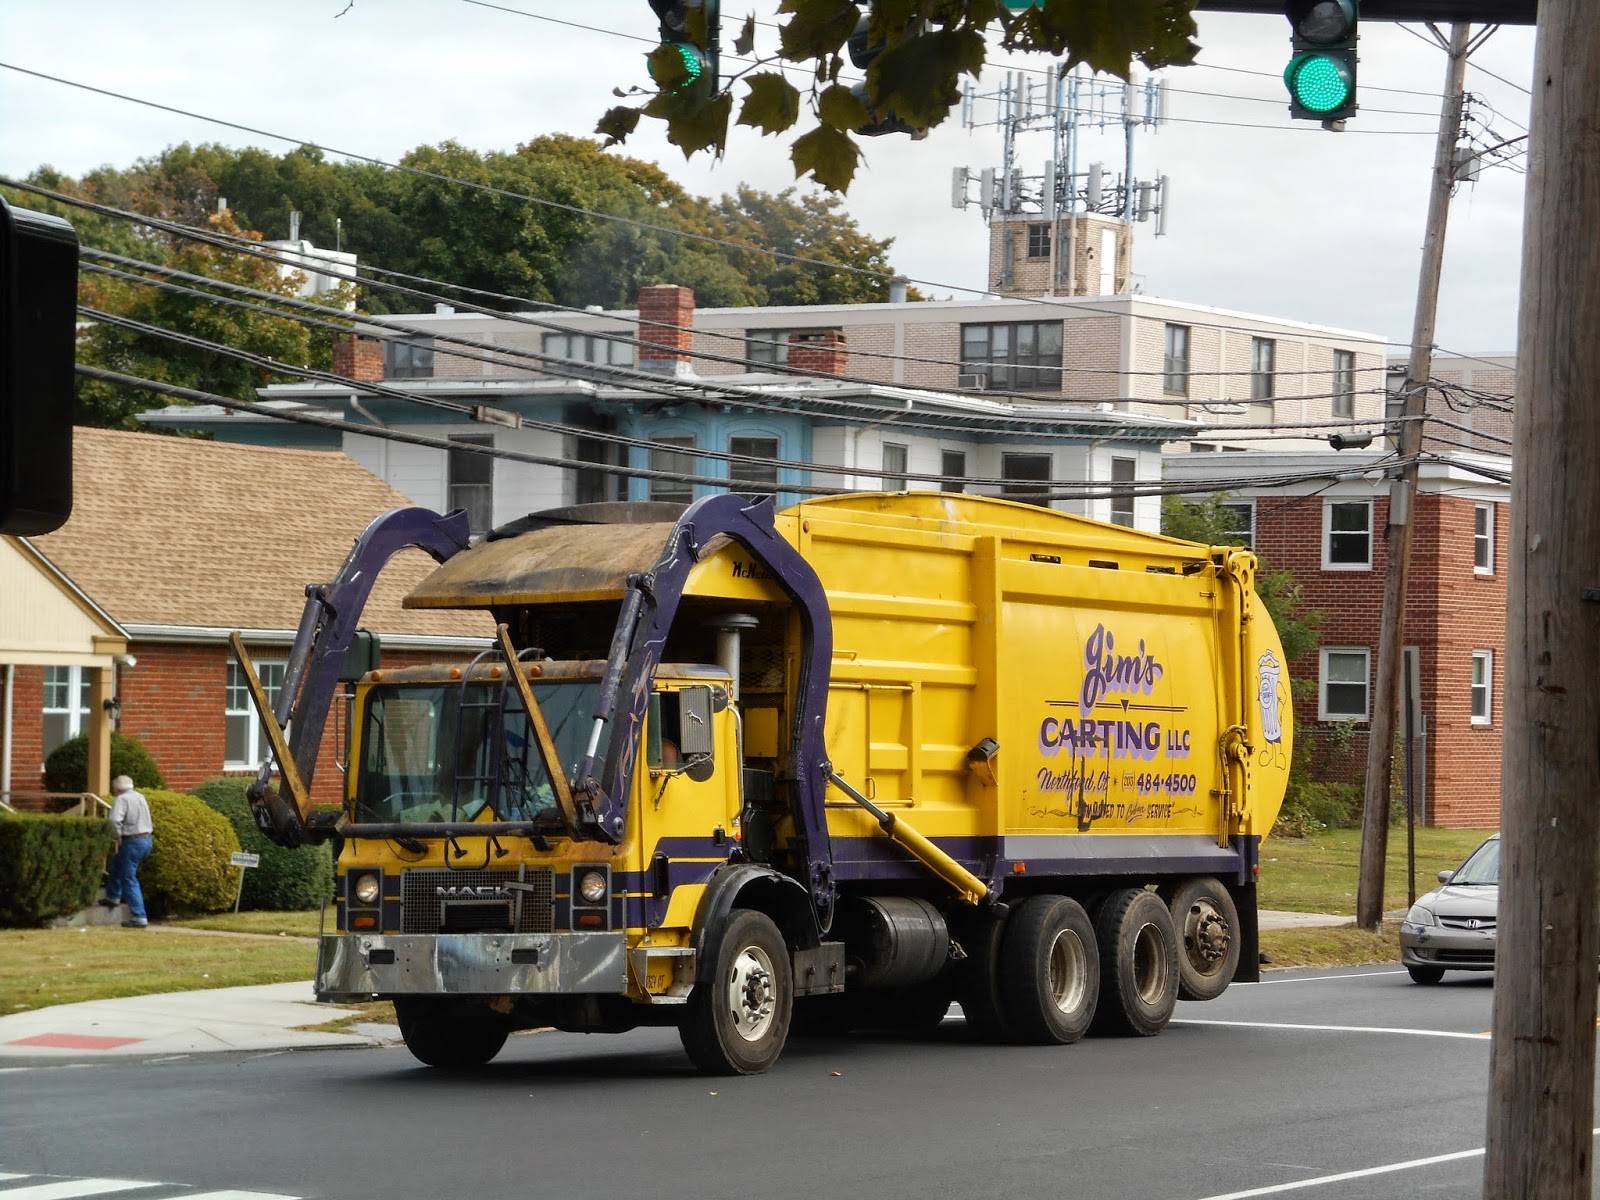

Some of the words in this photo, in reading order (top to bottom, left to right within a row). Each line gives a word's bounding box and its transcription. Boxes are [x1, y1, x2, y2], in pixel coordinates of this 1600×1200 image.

[1081, 623, 1164, 714] Jim's
[1039, 716, 1161, 758] CARTING
[1166, 729, 1191, 757] LLC
[1116, 804, 1125, 819] TO
[436, 886, 514, 897] MACK
